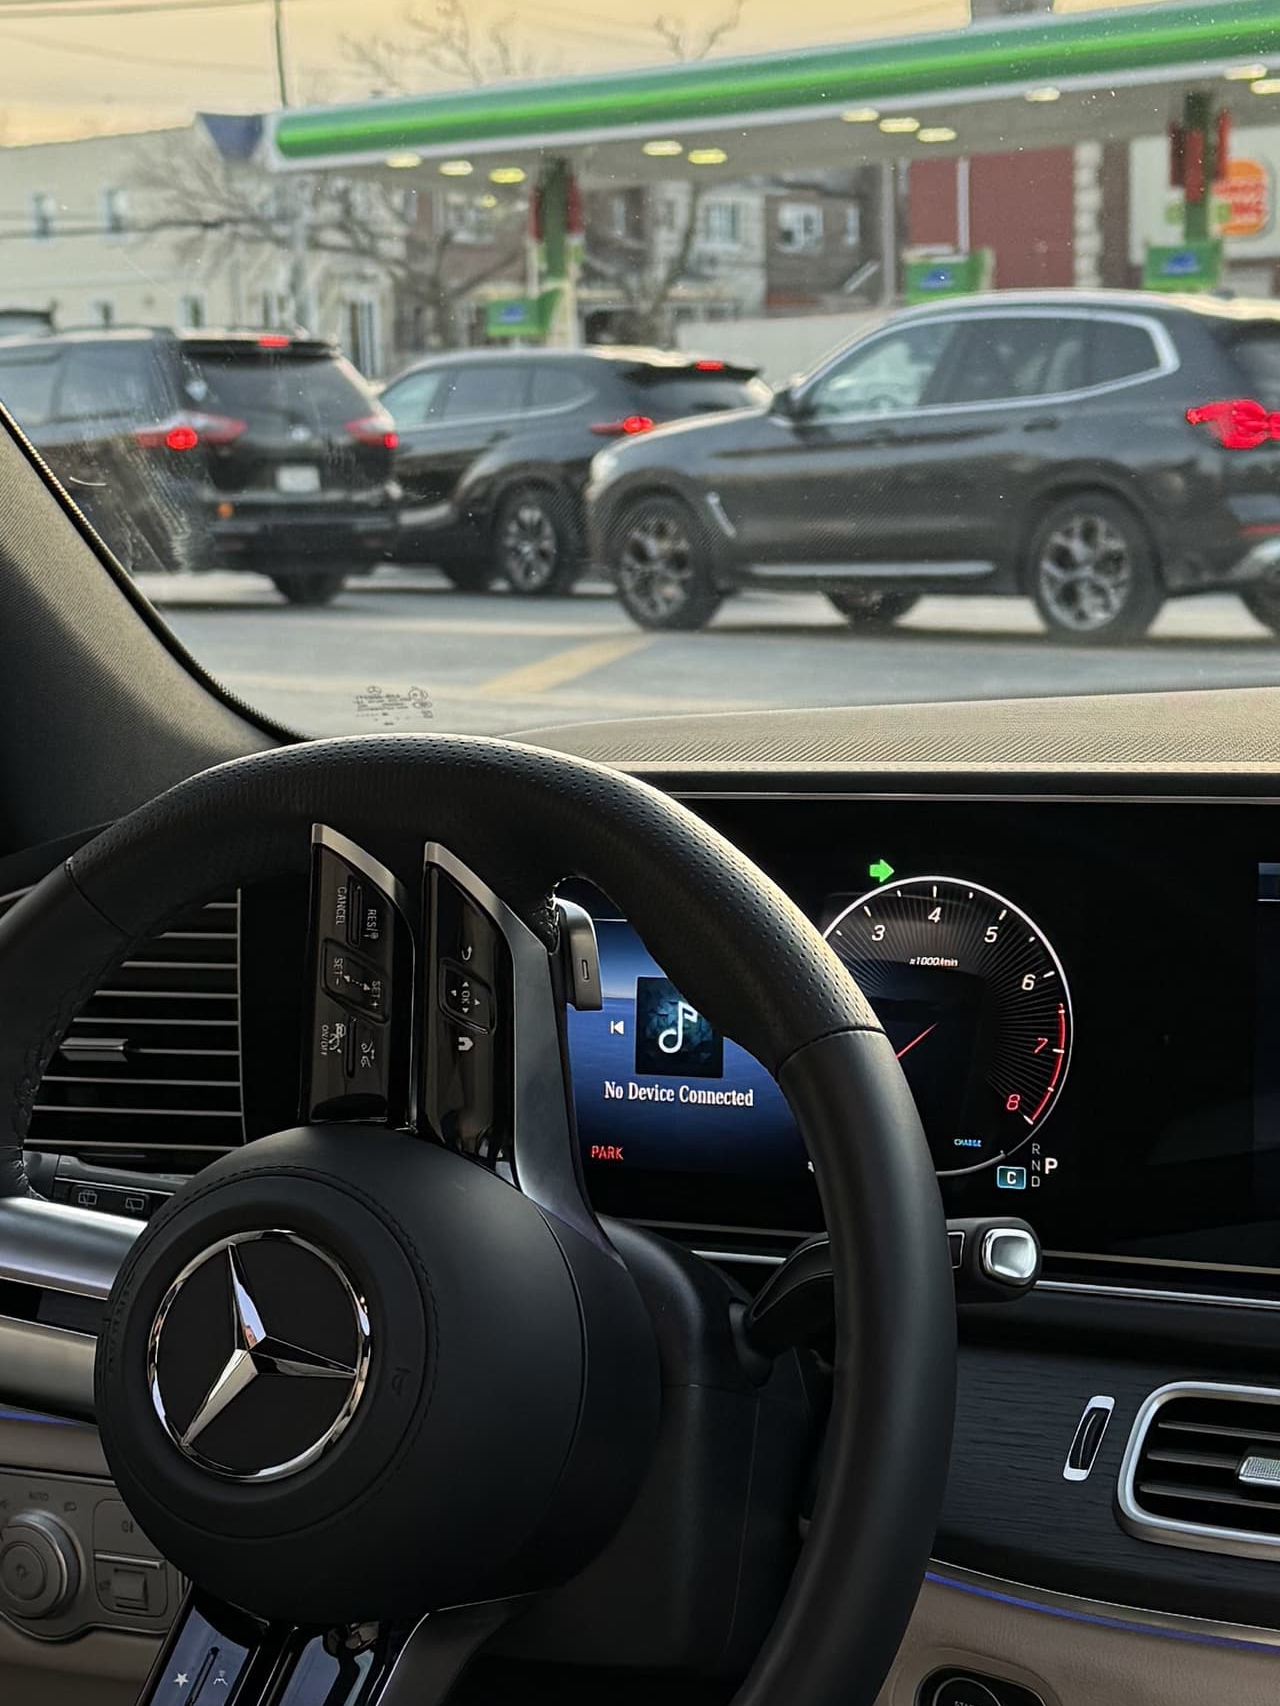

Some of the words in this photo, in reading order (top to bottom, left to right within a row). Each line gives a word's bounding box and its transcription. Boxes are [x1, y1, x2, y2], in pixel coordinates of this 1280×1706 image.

[335, 886, 347, 925] CANCEL
[928, 907, 942, 923] 4
[872, 924, 886, 941] 3
[984, 926, 999, 943] 5
[334, 957, 344, 976] SET
[371, 980, 381, 999] SET
[1021, 974, 1036, 991] 6
[461, 990, 471, 1005] OK
[1033, 1037, 1049, 1054] 7
[604, 1081, 624, 1099] No
[628, 1082, 675, 1102] Device
[679, 1085, 754, 1107] Connected
[1006, 1094, 1021, 1111] 8
[591, 1145, 624, 1160] PARK
[1032, 1144, 1041, 1155] R
[1032, 1160, 1041, 1171] N
[1045, 1157, 1058, 1174] P
[1006, 1172, 1017, 1184] C
[1032, 1176, 1041, 1187] D
